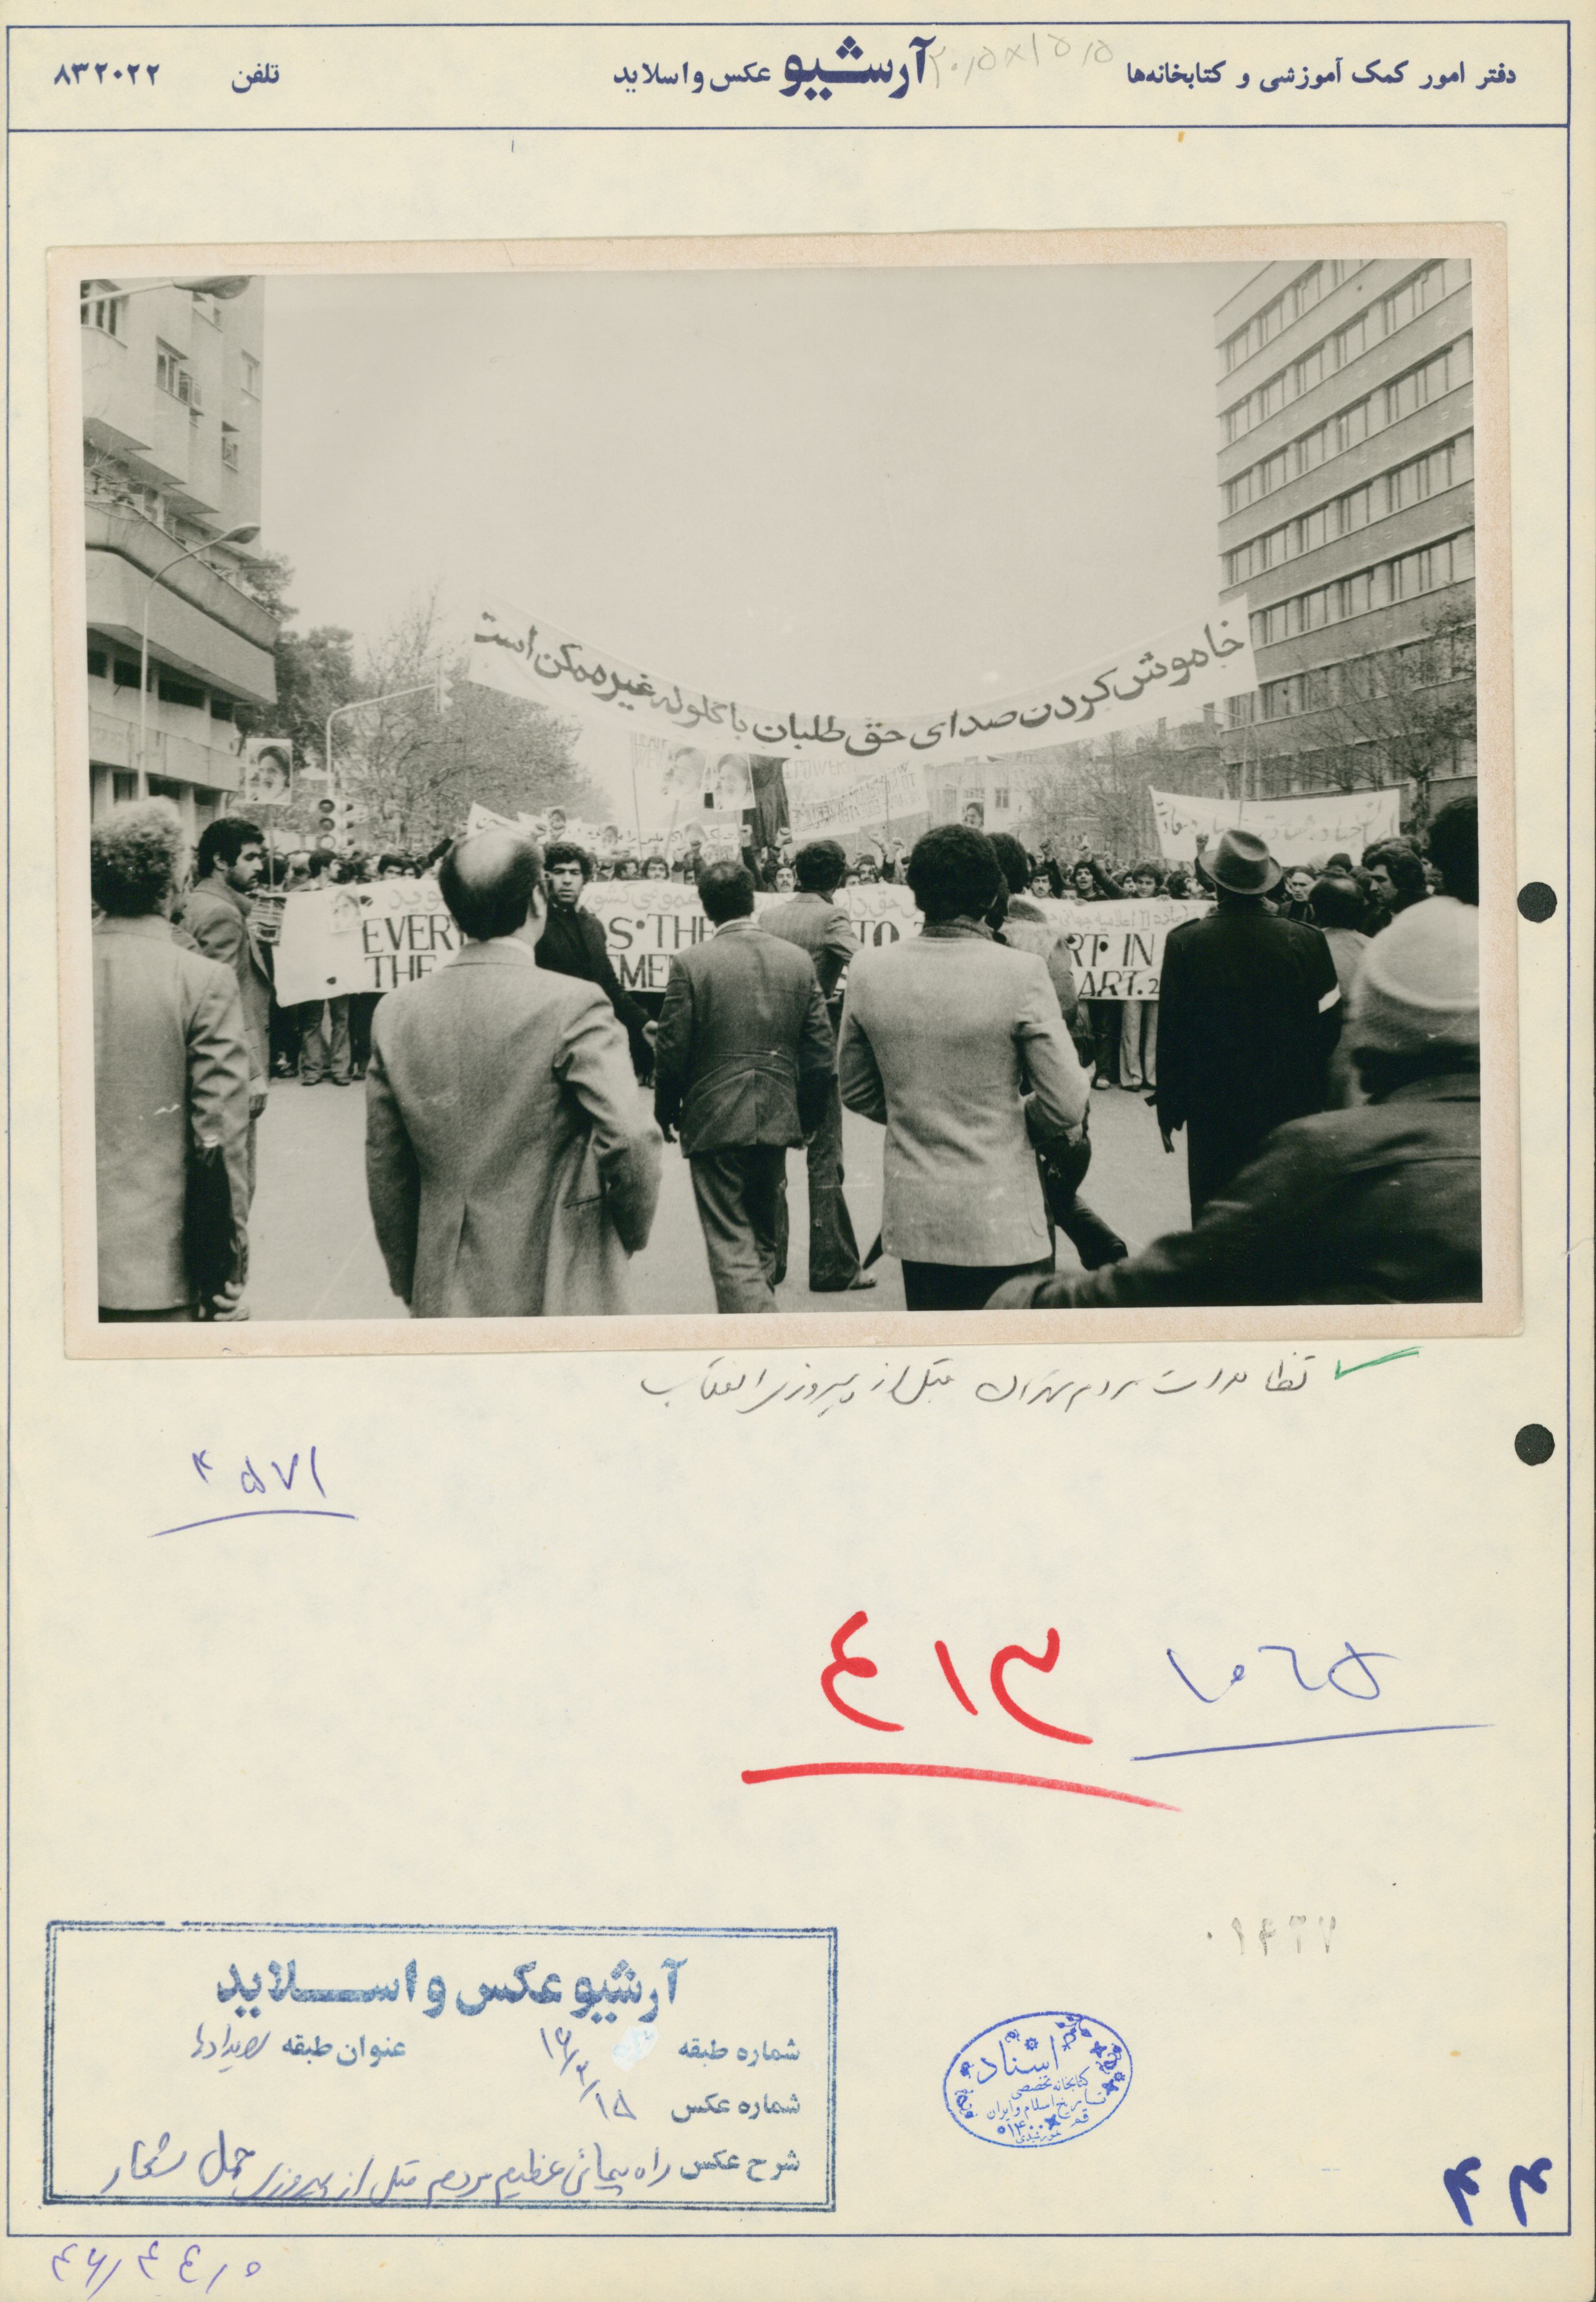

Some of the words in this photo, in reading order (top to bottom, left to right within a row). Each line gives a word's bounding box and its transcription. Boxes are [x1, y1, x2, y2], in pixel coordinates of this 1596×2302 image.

[53, 63, 161, 87] ۸۳۲۰۲۲
[230, 62, 280, 93] تلفن
[612, 62, 689, 93] اسلاید
[692, 70, 705, 94] و
[709, 61, 771, 90] عکس
[779, 35, 936, 101] آرشیو
[1235, 72, 1250, 88] و
[1259, 57, 1343, 92] آموزشی
[1351, 60, 1409, 84] کمک
[1418, 61, 1464, 89] امور
[1476, 62, 1516, 90] دفتر
[474, 612, 537, 660] است
[534, 644, 606, 686] ممکن
[1113, 620, 1245, 700] خاموش
[592, 673, 656, 710] غیر
[1019, 668, 1118, 729] کردن
[730, 702, 748, 739] با
[753, 712, 845, 749] طلبان
[845, 717, 906, 756] حق
[910, 710, 1016, 749] صدای
[851, 920, 899, 947] TO
[1122, 933, 1155, 966] IN
[217, 1958, 418, 2019] اسلاید
[422, 1974, 447, 2019] و
[456, 1960, 562, 2017] عکس
[569, 1958, 688, 2024] آرشیو
[282, 2033, 333, 2065] طبقه
[336, 2035, 406, 2068] عنوان
[678, 2038, 729, 2067] طبقه
[737, 2038, 800, 2067] شماره
[977, 2035, 1059, 2084] اسناد
[1053, 2066, 1090, 2092] کتابخانه
[671, 2093, 731, 2124] عکس
[738, 2093, 800, 2120] شماره
[679, 2149, 741, 2180] عکس
[746, 2149, 800, 2183] شرح
